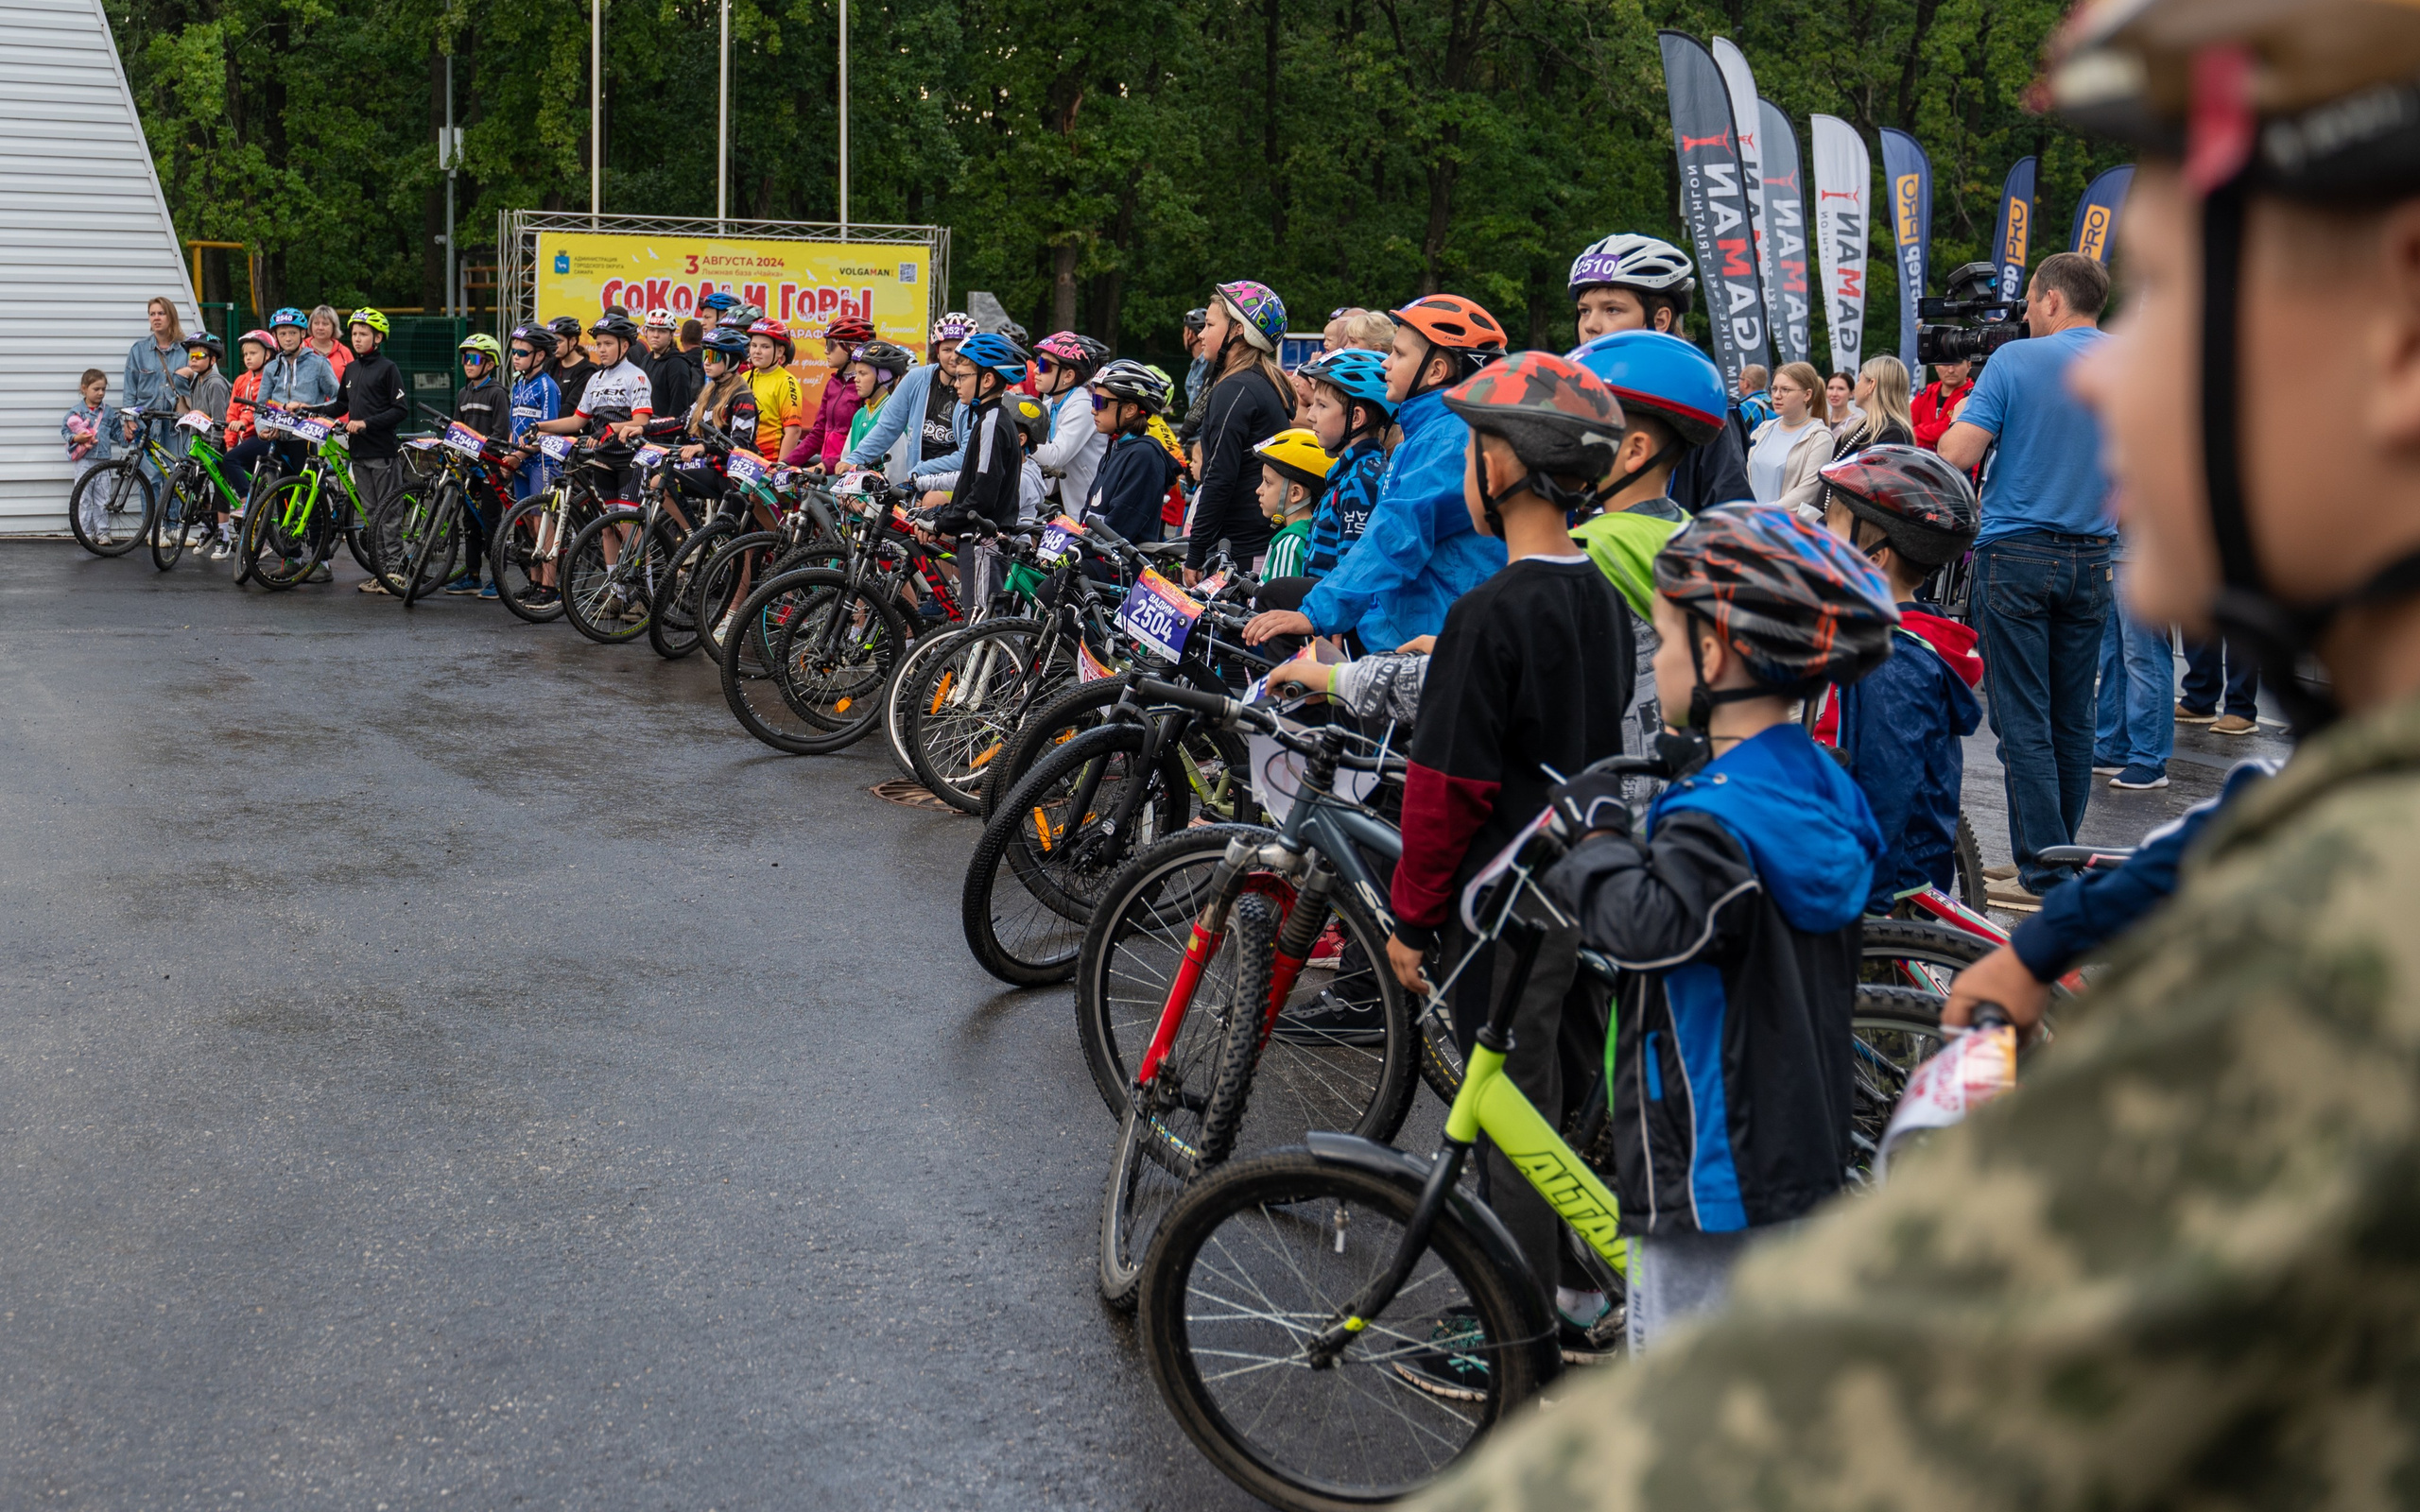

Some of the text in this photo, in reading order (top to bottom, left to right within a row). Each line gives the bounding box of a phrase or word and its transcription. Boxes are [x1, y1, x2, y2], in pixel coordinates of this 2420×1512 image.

[684, 254, 785, 275] 3 АВГУСТА 2024
[701, 267, 734, 276] Лыжная
[735, 268, 752, 277] база
[838, 267, 890, 277] VOLGAMAN
[1576, 257, 1616, 276] 2510
[602, 279, 767, 318] СОКОЛИ
[789, 328, 823, 339] АРАФ
[944, 326, 964, 335] 2521
[590, 388, 627, 397] TREK
[787, 375, 798, 407] KENDA
[301, 421, 325, 439] 2534
[451, 430, 480, 450] 2546
[541, 436, 564, 453] 2529
[729, 460, 756, 477] 2523
[1148, 593, 1177, 617] ВАДИМ
[1130, 598, 1173, 644] 2504
[1229, 653, 1270, 674] 680
[1922, 886, 1953, 907] ENILE
